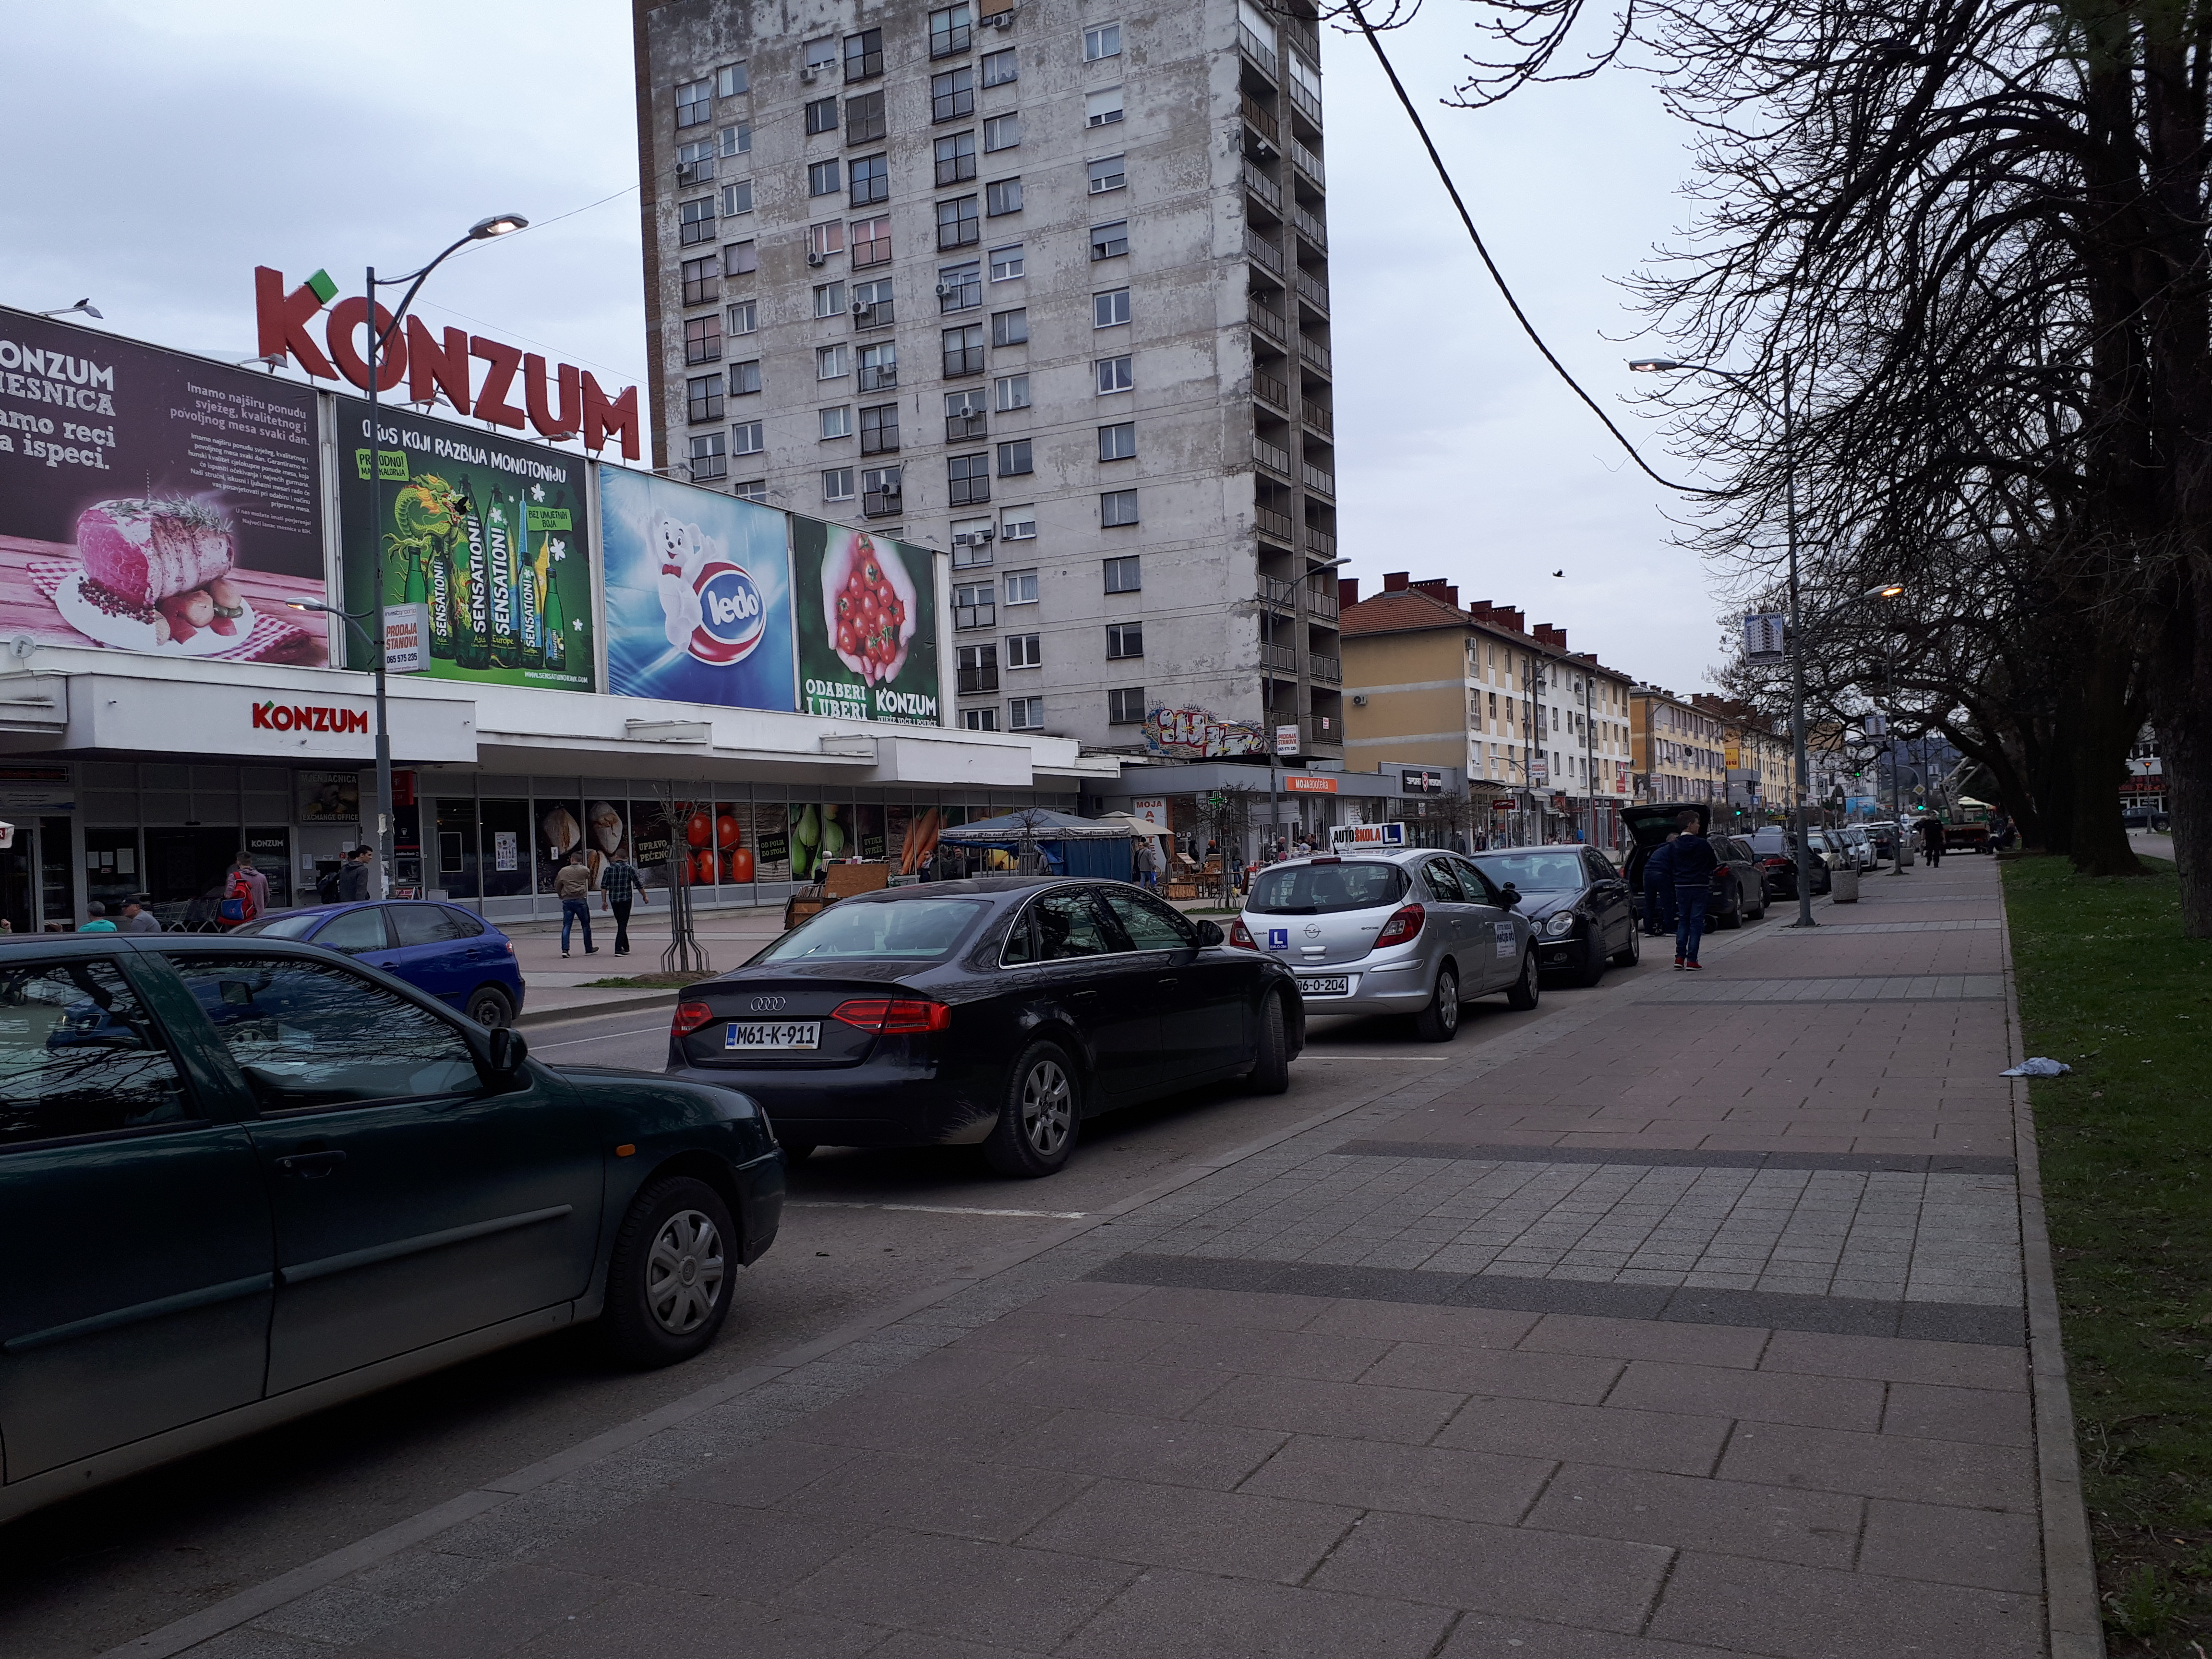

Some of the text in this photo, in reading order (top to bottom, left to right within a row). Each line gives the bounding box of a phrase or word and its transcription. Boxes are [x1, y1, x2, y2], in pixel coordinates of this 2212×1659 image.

[0, 340, 114, 391] ONZUM
[254, 264, 640, 460] KONZUM
[187, 382, 306, 419] Imamo najširu ponudu
[170, 408, 311, 446] povoljnog mesa svaki dan.
[195, 399, 307, 433] svježeg, kvalitetnog i
[0, 409, 116, 447] amo reci
[23, 433, 110, 470] ispeci.
[191, 433, 211, 443] Imamo
[232, 442, 253, 452] ponudu
[276, 451, 306, 464] kvalitetnog
[194, 443, 223, 455] povoljnog
[267, 458, 301, 470] Garantiramo
[402, 430, 431, 452] KOJI
[435, 438, 488, 465] RAZBIJA
[188, 449, 207, 459] hunski
[208, 454, 229, 464] kvalitet
[231, 459, 260, 470] cjelokupne
[261, 465, 281, 474] ponude
[191, 468, 204, 476] Naši
[207, 462, 228, 472] ispuniti
[269, 493, 289, 501] odabiru
[271, 501, 295, 510] pripreme
[542, 519, 557, 528] BOJA
[491, 528, 511, 636] SENSATION!
[523, 579, 536, 648] SENSATION!
[708, 586, 759, 625] ledo
[386, 622, 417, 638] PRODAJA
[473, 635, 486, 643] Asia
[492, 634, 515, 647] Europe
[386, 635, 418, 650] STANOVA
[387, 653, 417, 664] 065 575 235
[805, 679, 866, 701] ODABERI
[806, 697, 867, 720] I UBERI
[876, 687, 936, 716] KONZUM
[253, 700, 368, 733] KONZUM
[1406, 777, 1421, 786] SPORT
[638, 840, 667, 851] UPRAVO
[639, 851, 669, 862] PEČENO
[770, 847, 786, 855] STOLA
[1274, 931, 1284, 944] L
[736, 1025, 815, 1045] M61-K-911
